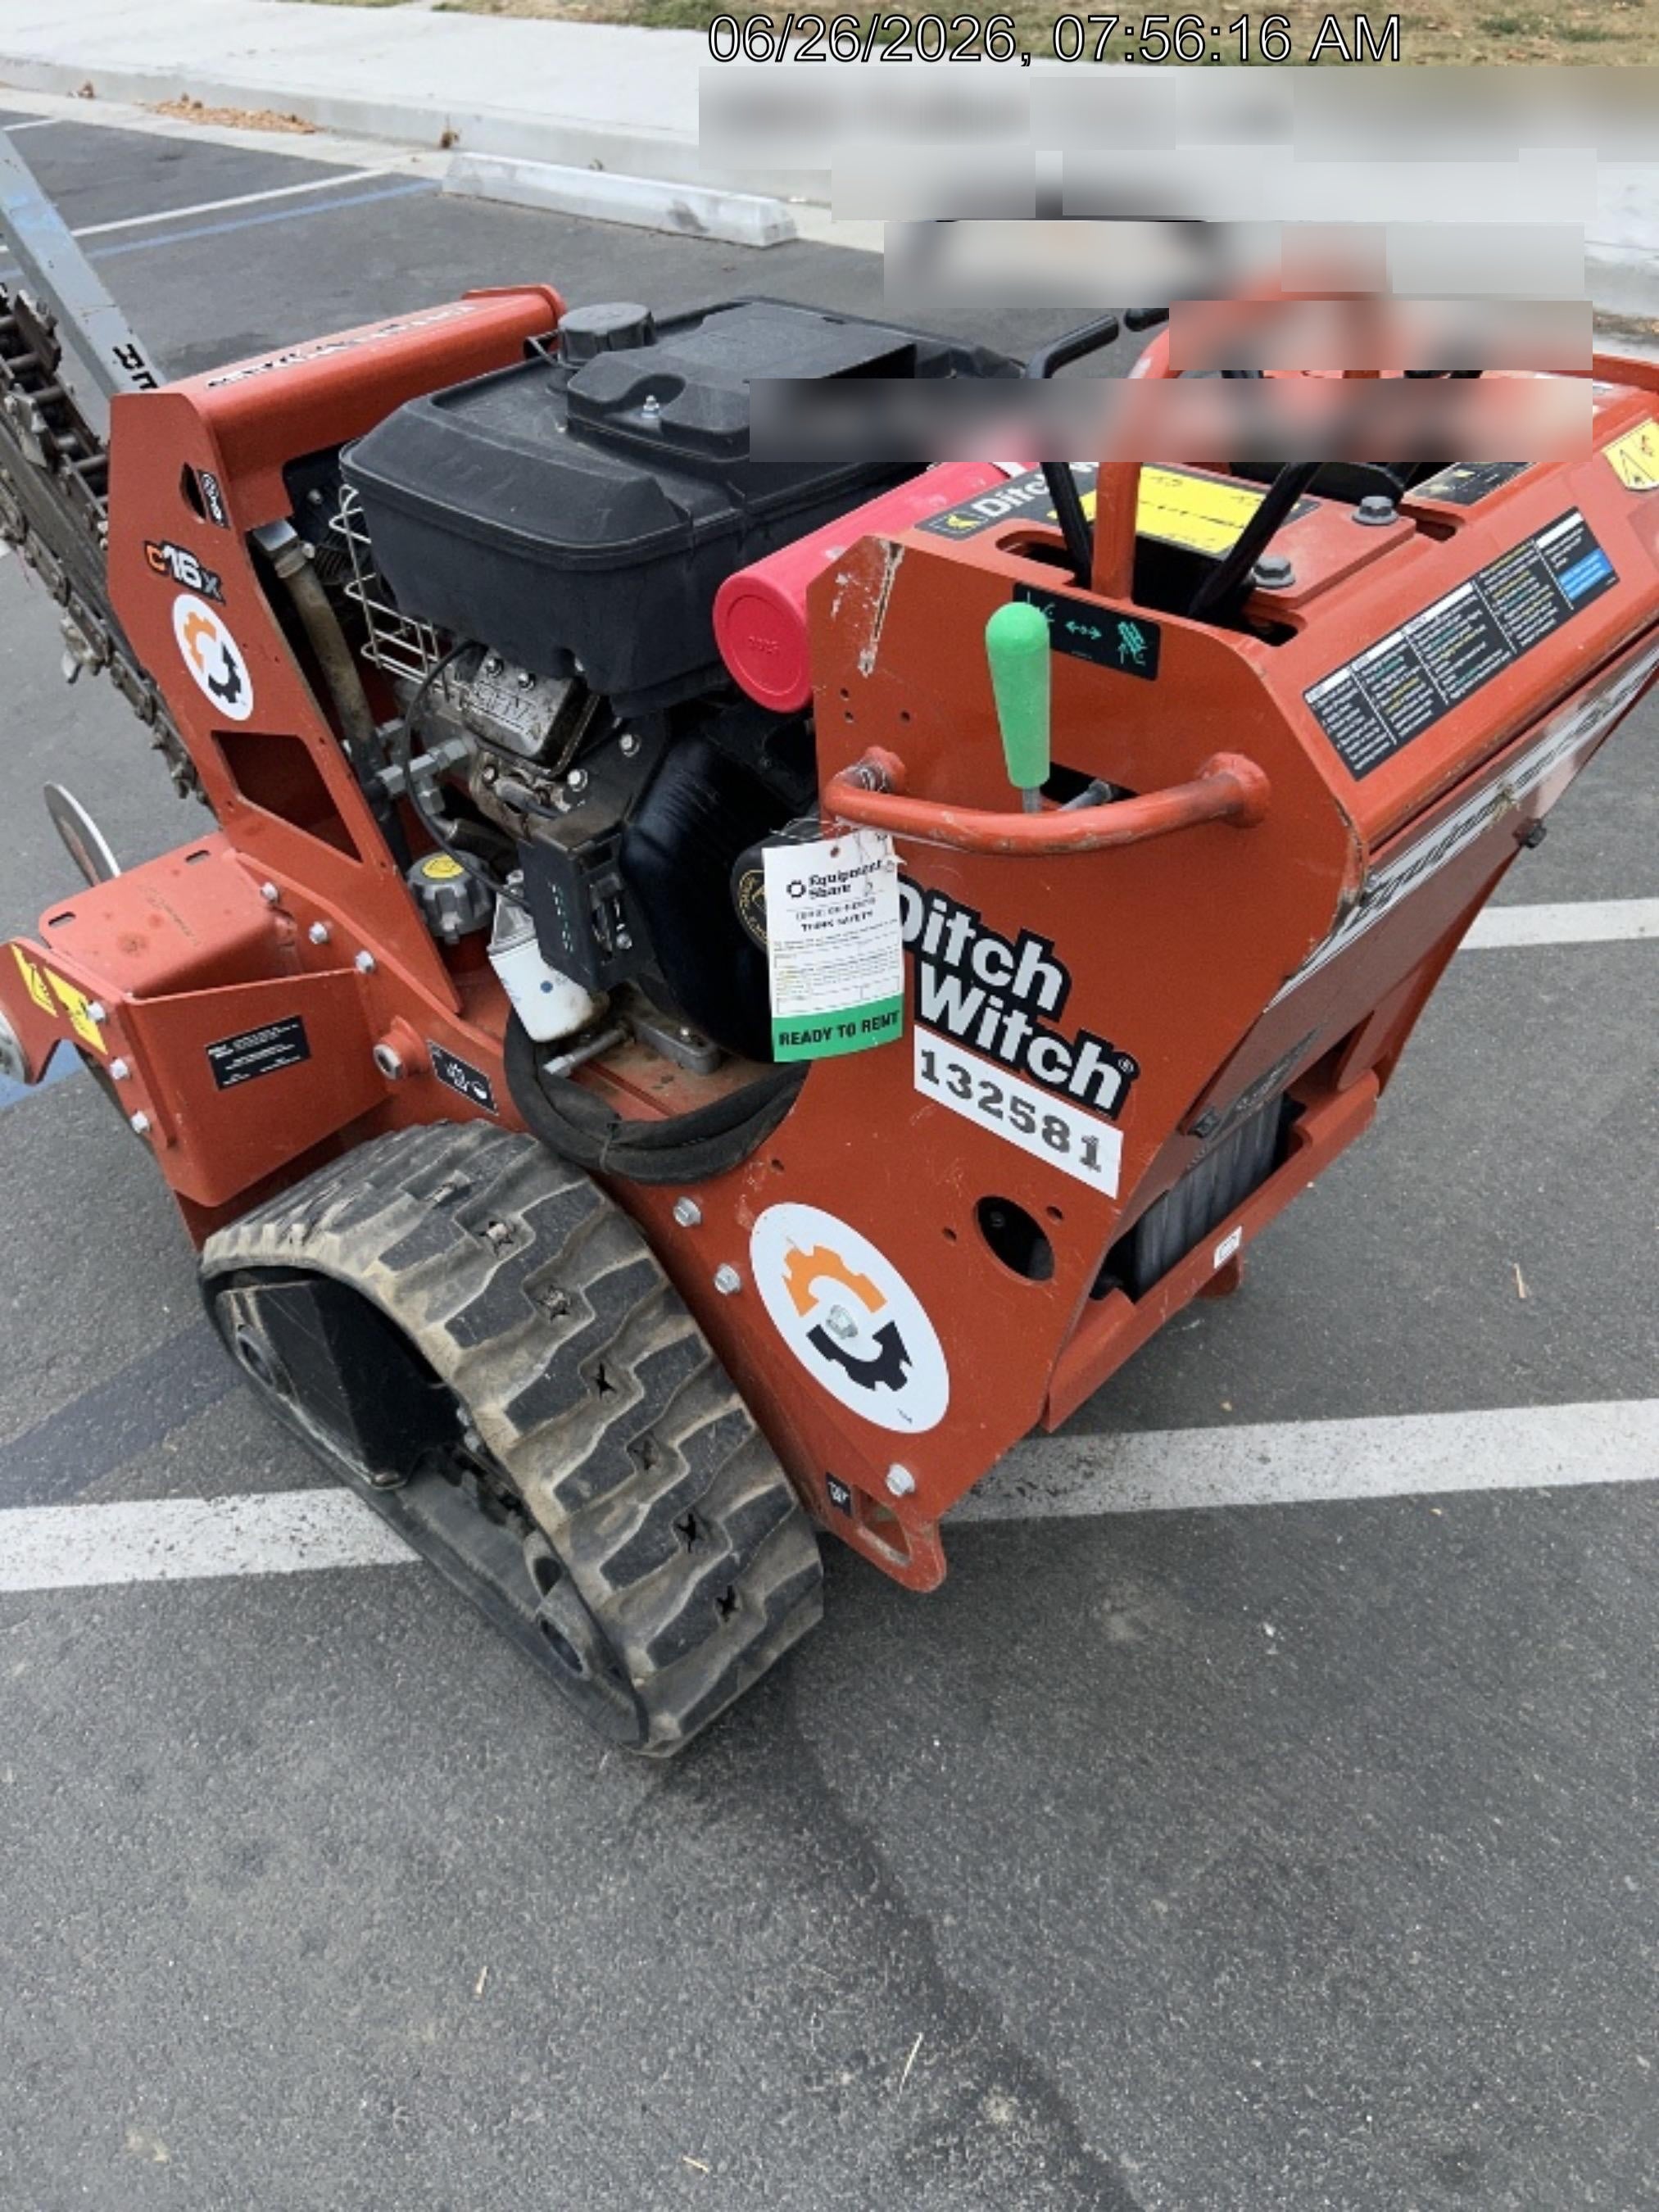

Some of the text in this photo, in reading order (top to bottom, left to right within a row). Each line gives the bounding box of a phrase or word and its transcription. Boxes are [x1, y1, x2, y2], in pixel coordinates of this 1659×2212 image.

[778, 1009, 901, 1046] READY TO RENT
[921, 1049, 1102, 1173] 132581
